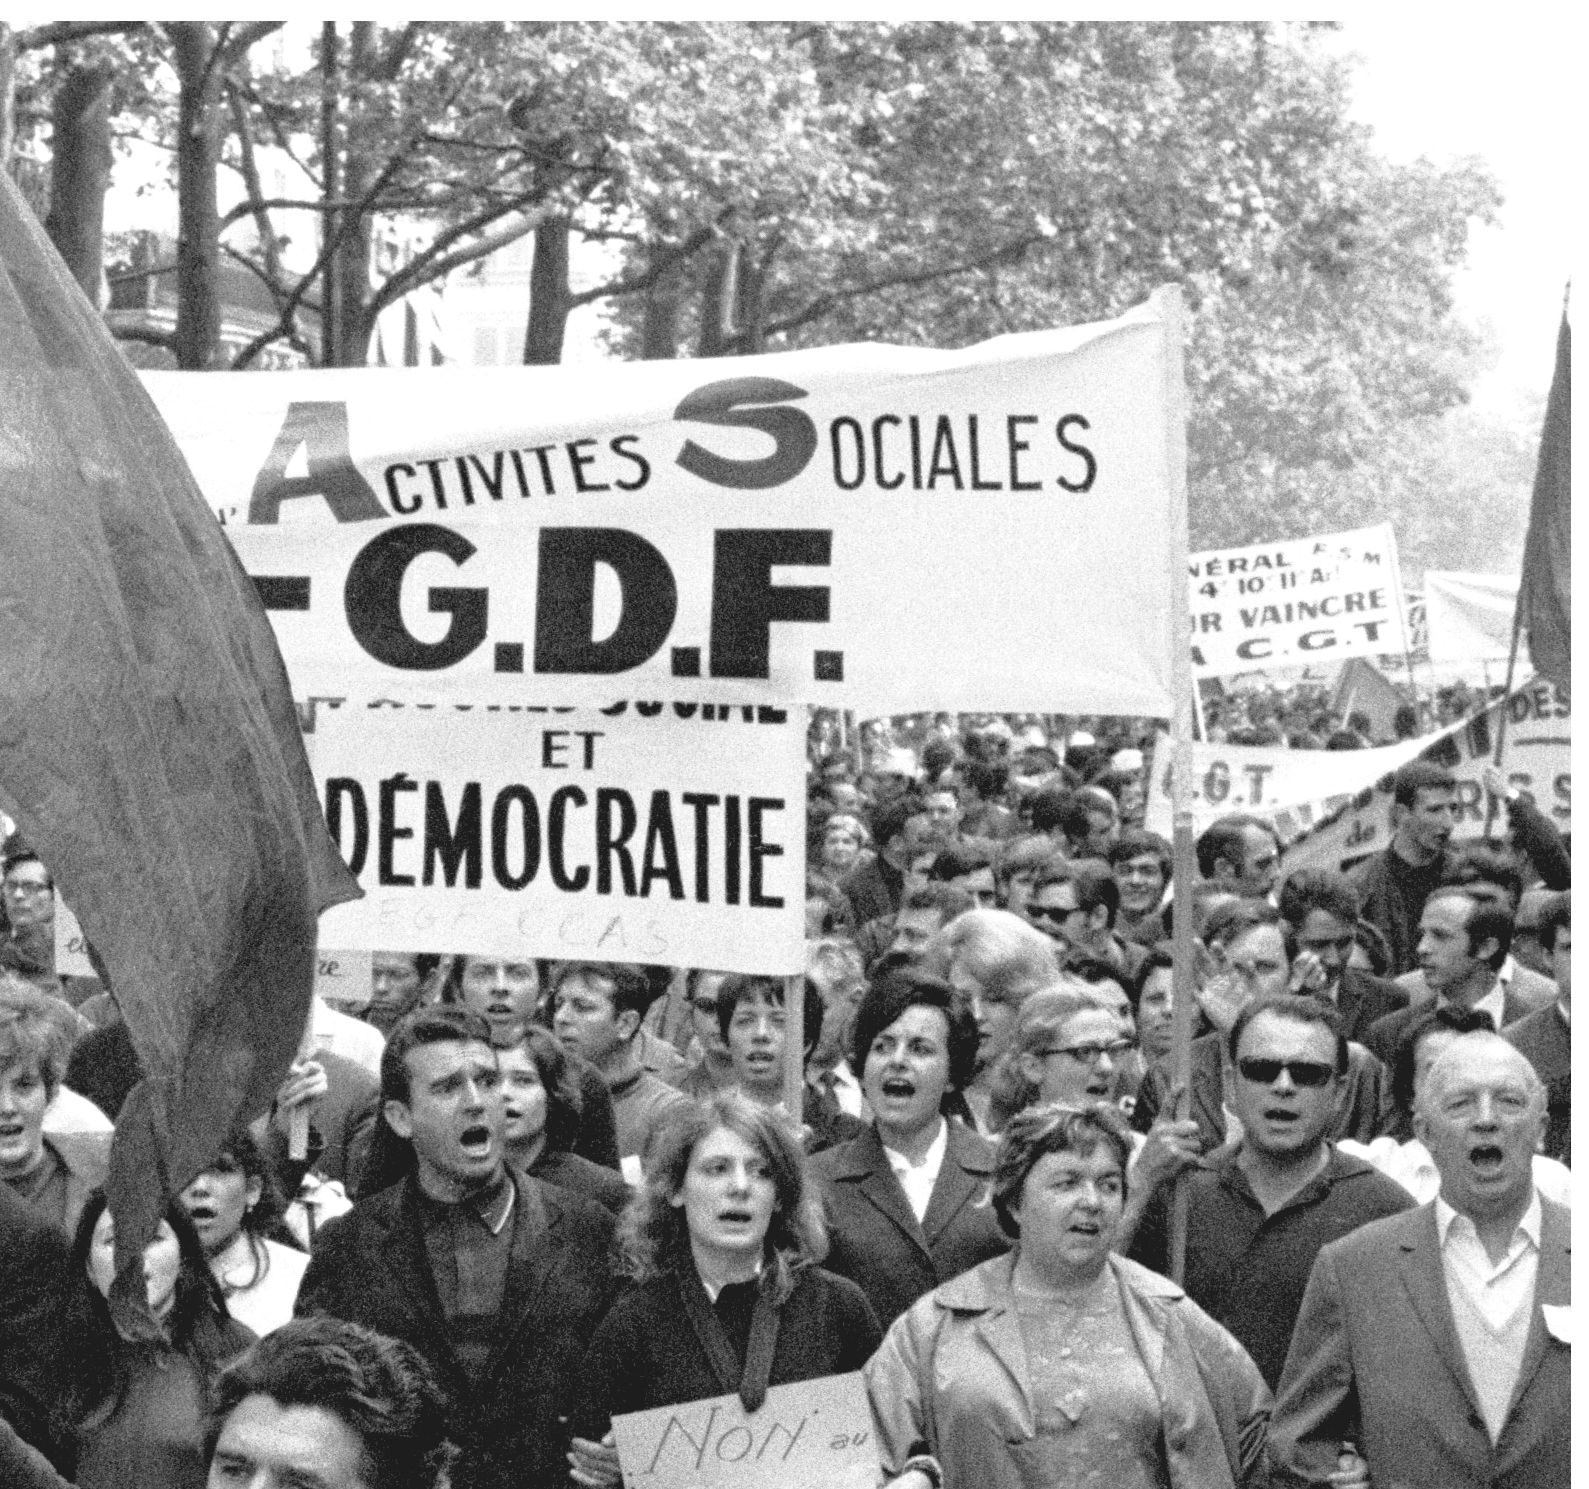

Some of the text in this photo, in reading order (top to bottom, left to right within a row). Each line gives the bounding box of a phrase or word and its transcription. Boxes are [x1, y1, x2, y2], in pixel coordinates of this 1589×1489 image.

[248, 400, 651, 526] ACTIVITES
[673, 376, 1098, 492] SOCIALES
[1240, 587, 1388, 628] VAINCRE
[542, 730, 605, 770] ET
[325, 773, 786, 908] DÉMOCRATIE
